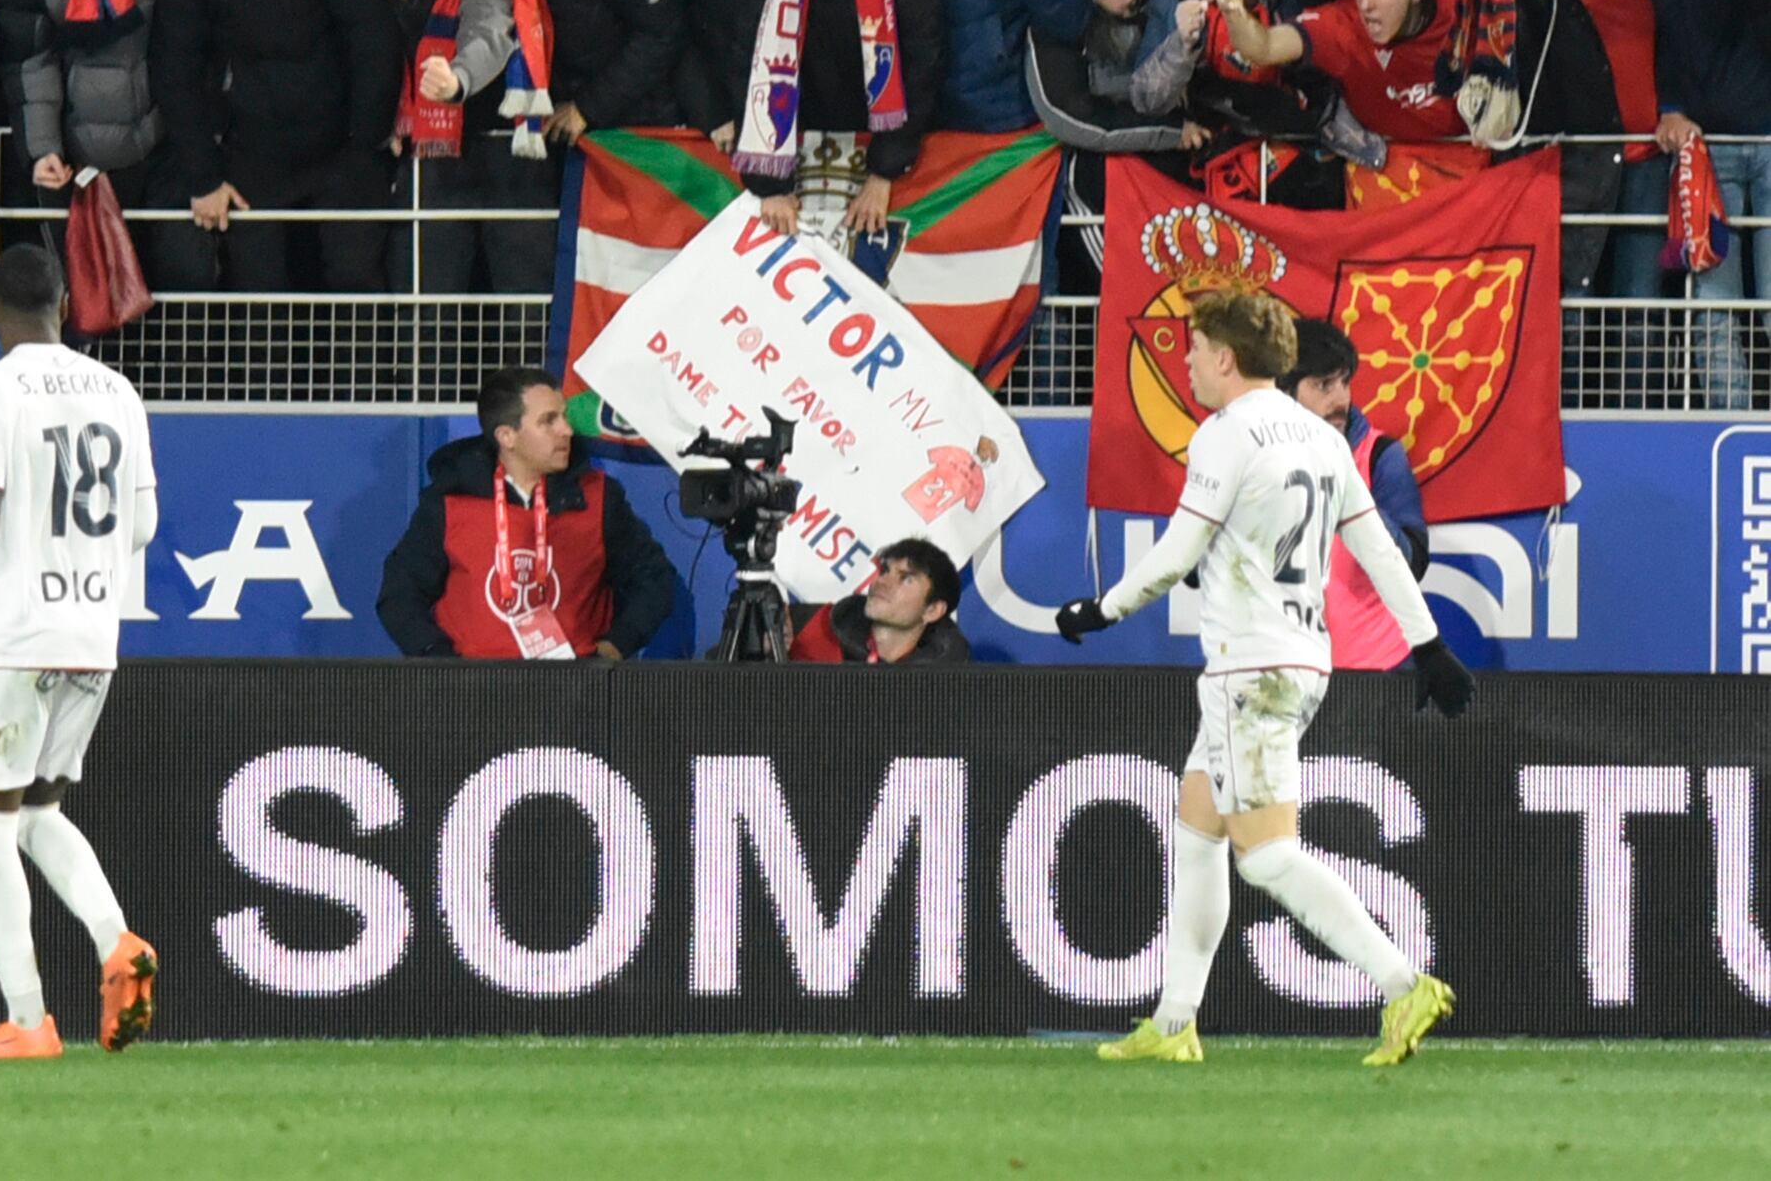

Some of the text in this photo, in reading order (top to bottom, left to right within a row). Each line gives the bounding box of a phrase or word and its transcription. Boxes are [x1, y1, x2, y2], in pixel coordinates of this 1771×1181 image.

[720, 305, 781, 374] POR
[733, 216, 905, 390] VICTOR
[43, 373, 119, 396] BECKER
[646, 330, 719, 408] DAME
[42, 421, 123, 538] 18
[1274, 469, 1336, 585] 21
[211, 745, 1435, 1009] SOMOS
